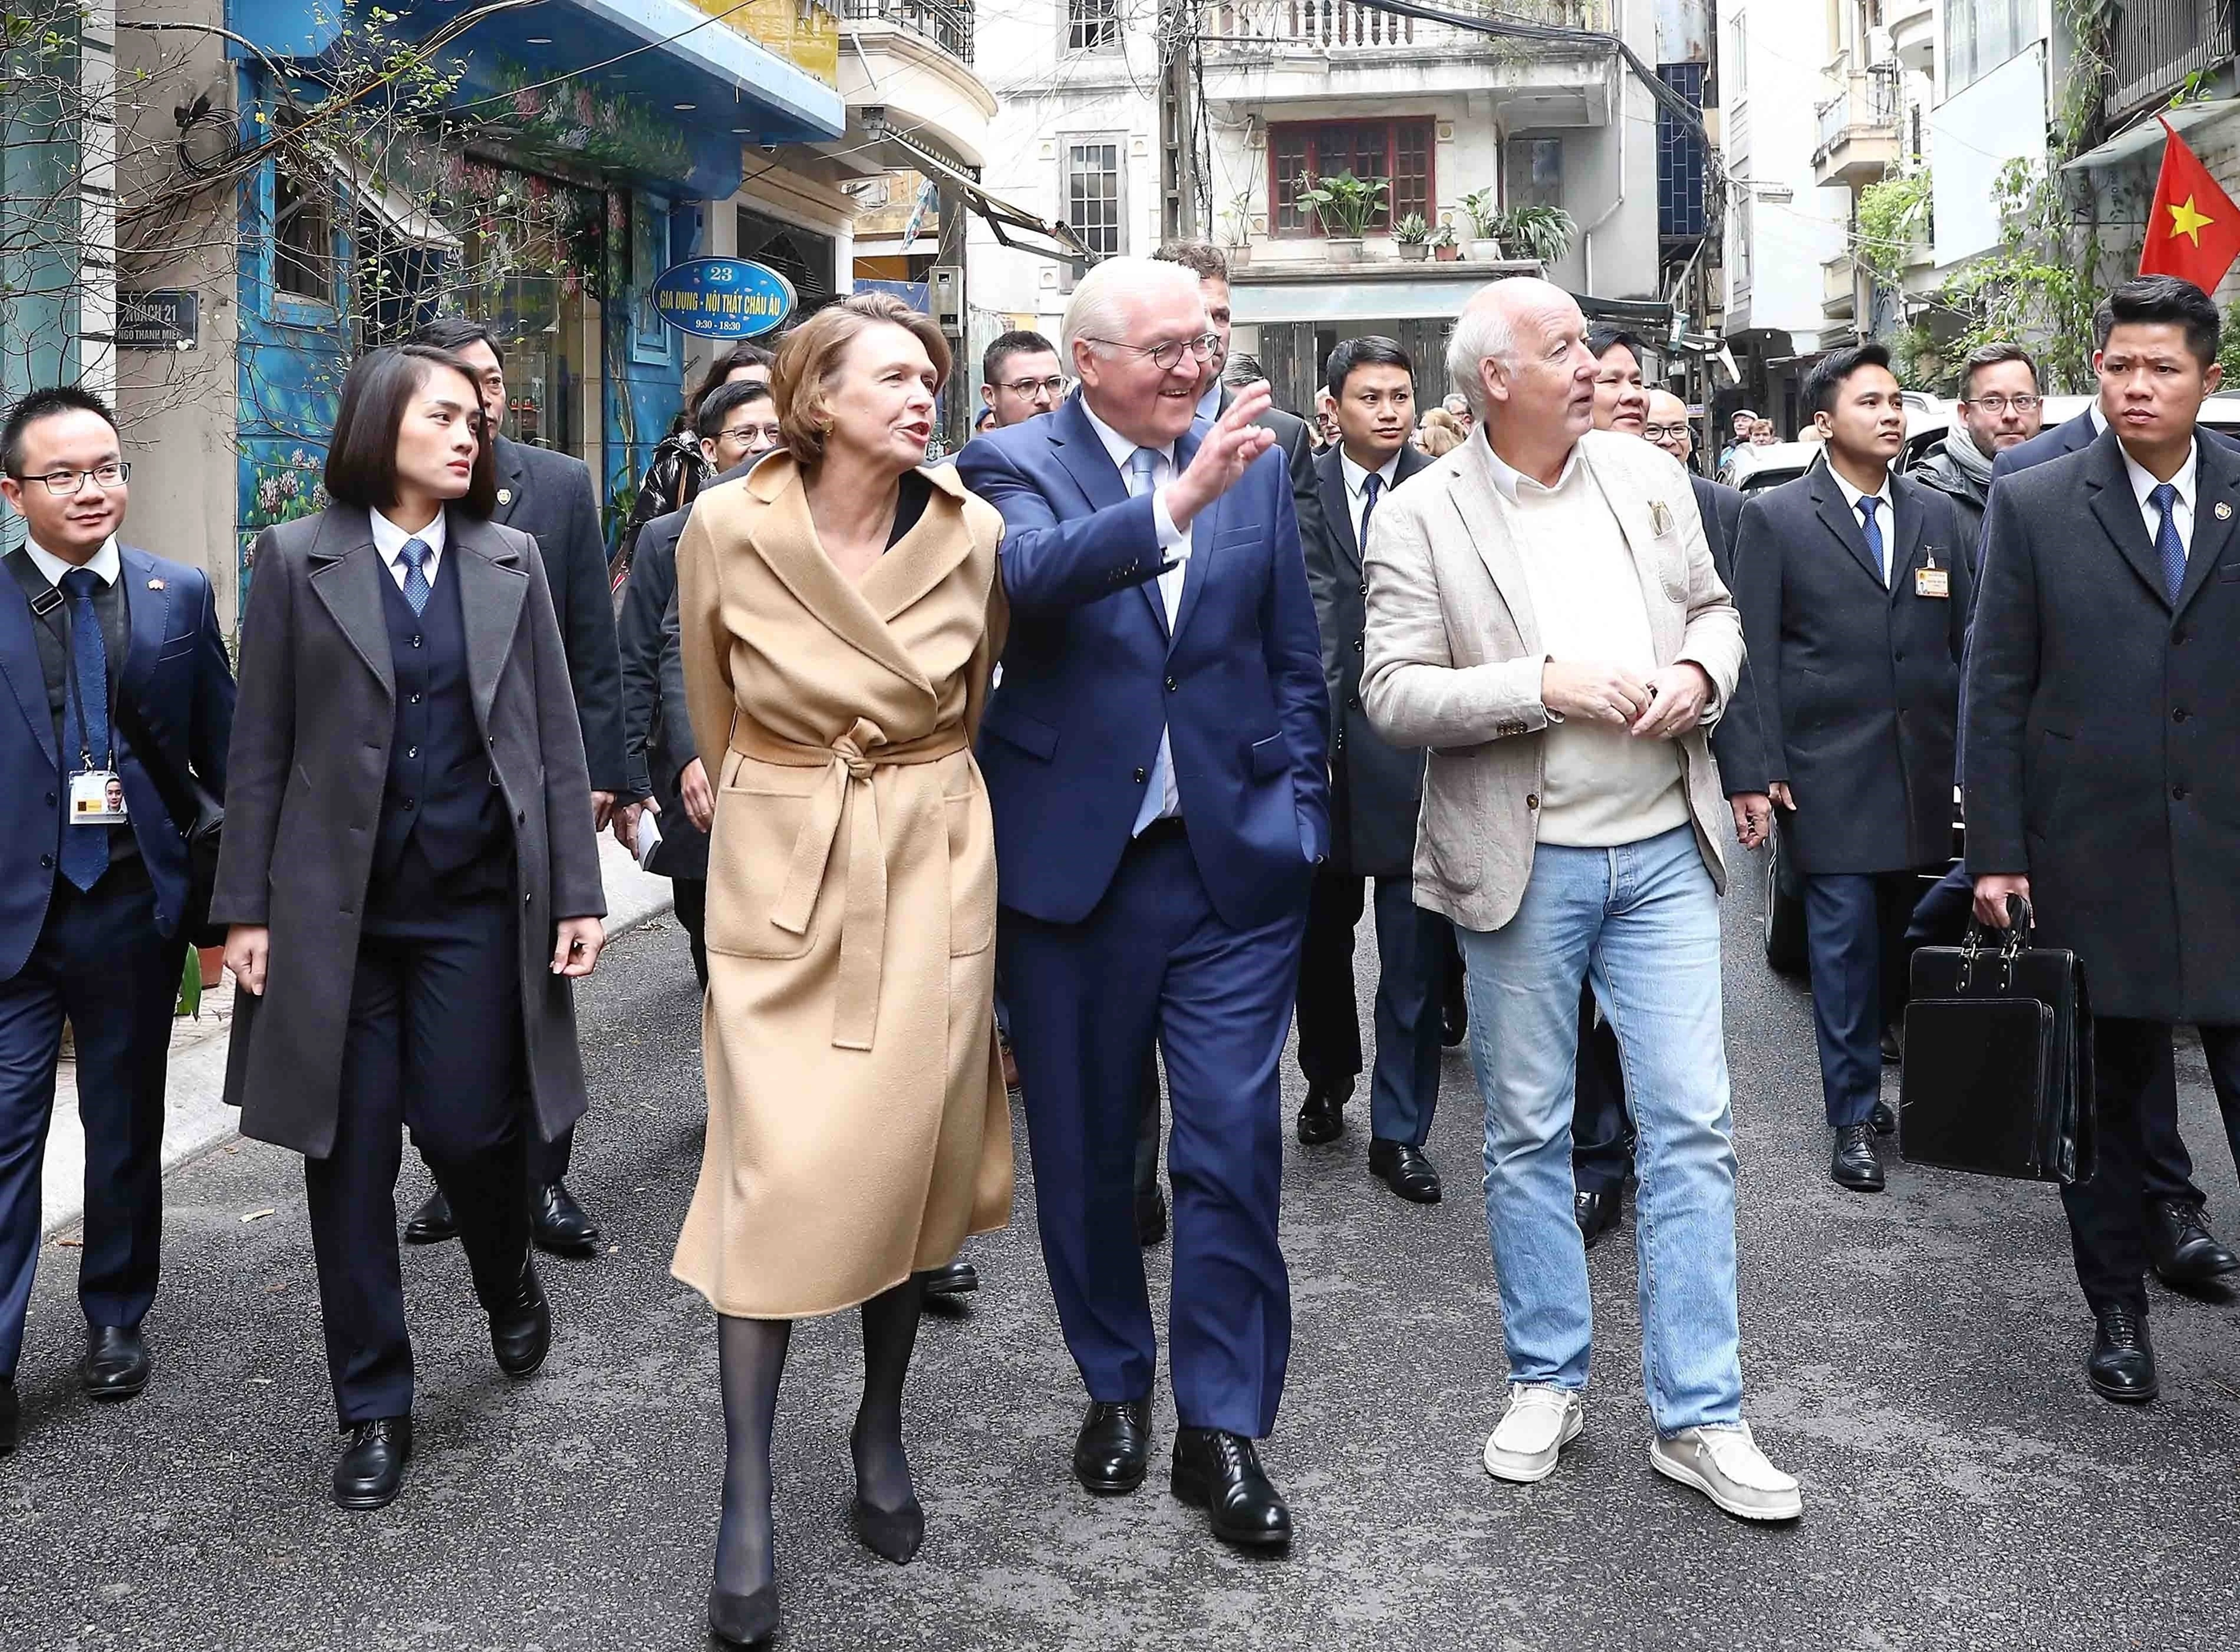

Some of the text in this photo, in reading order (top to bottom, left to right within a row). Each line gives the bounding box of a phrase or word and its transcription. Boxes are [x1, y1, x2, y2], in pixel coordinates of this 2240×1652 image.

[710, 266, 733, 282] 23
[660, 290, 674, 309] GIA
[675, 291, 698, 314] DỤNG
[705, 290, 720, 317] NỘI
[722, 288, 742, 314] THẤT
[744, 292, 767, 315] CHÂU
[768, 293, 781, 317] ÂU
[164, 305, 176, 322] 21
[695, 320, 713, 329] 9:30
[719, 321, 741, 330] 18:30
